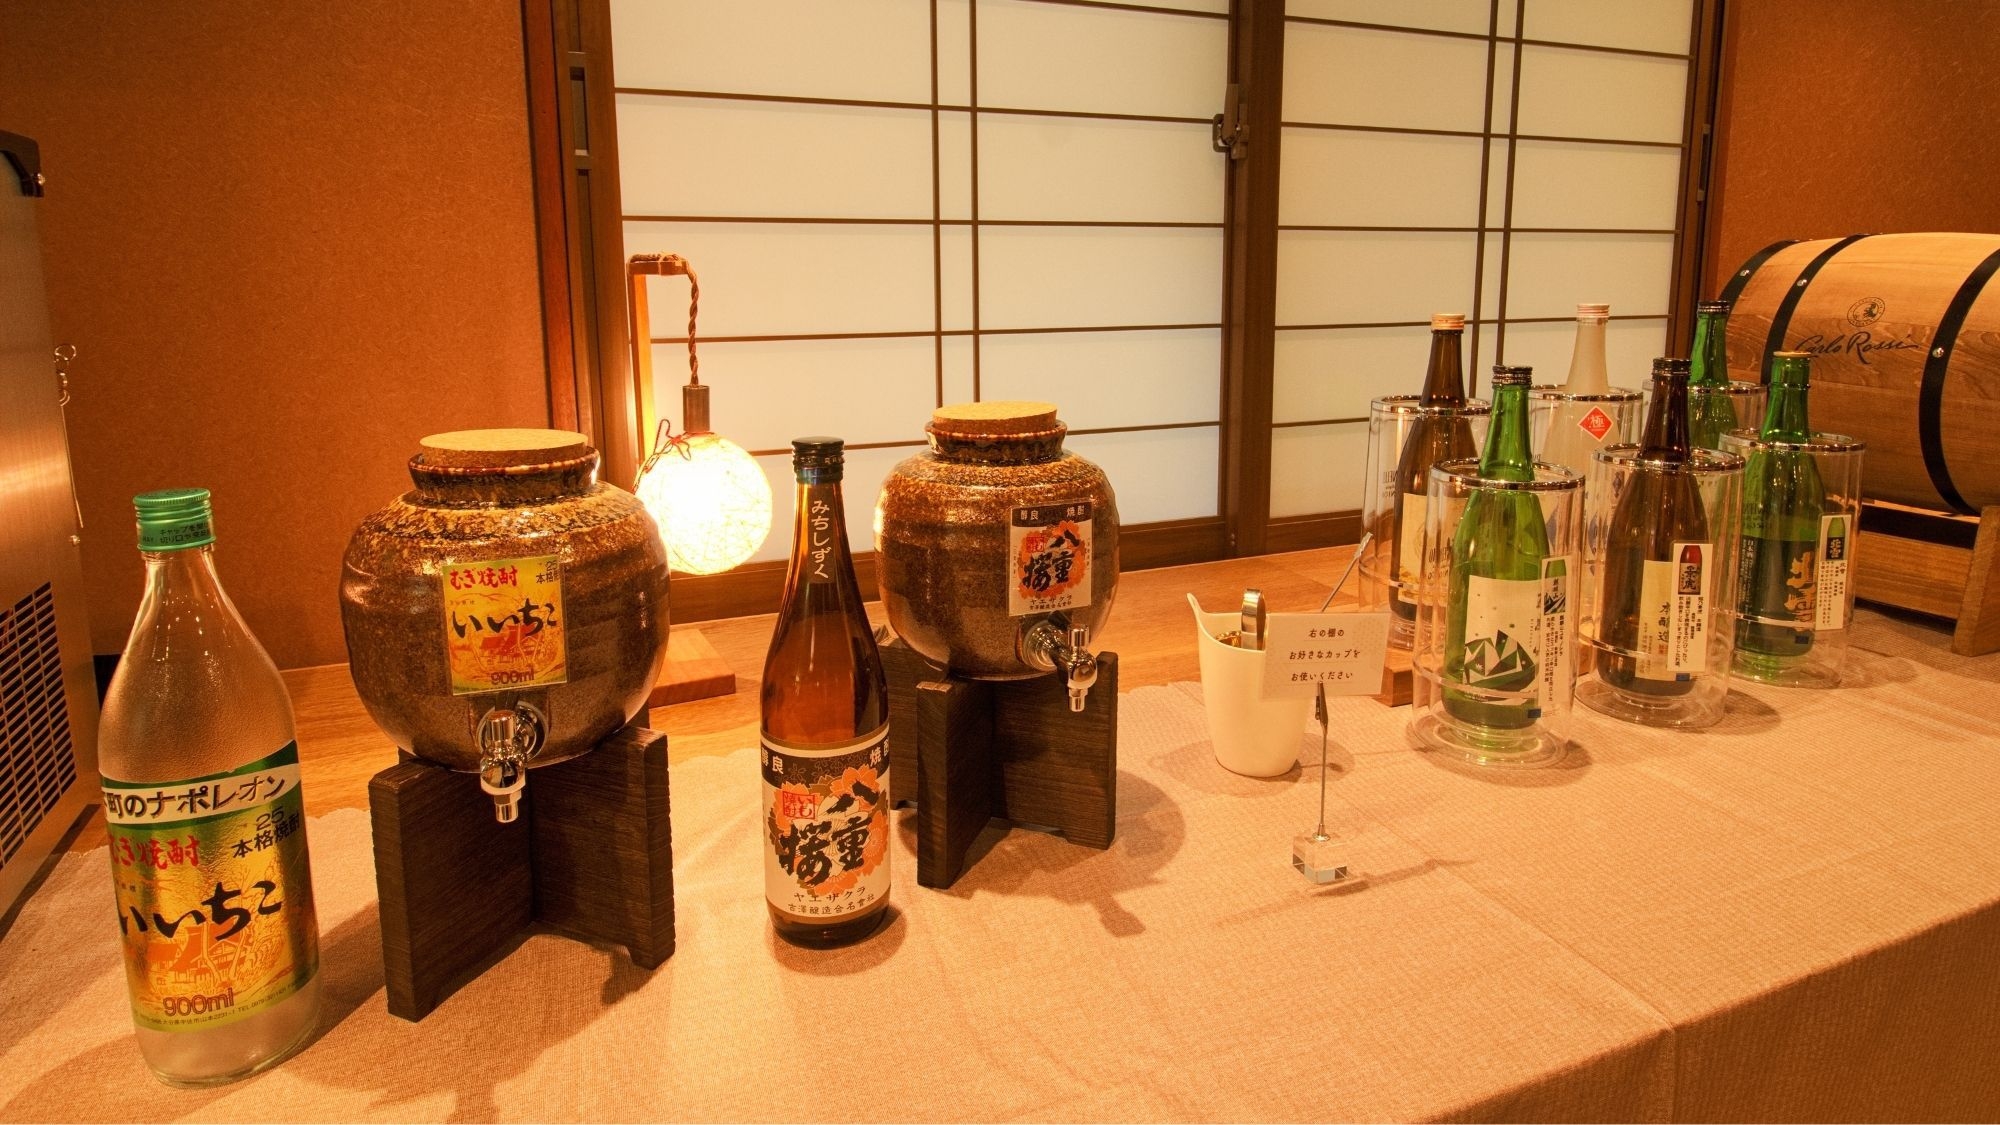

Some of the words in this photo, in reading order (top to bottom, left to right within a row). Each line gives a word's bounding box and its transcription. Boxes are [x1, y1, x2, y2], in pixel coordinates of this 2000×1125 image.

[1795, 334, 1846, 357] Carlo
[1846, 331, 1919, 365] Rossi
[811, 500, 832, 579] みちしずく
[450, 565, 518, 590] むぎ焼酎
[452, 598, 557, 638] いいちこ
[1309, 628, 1345, 638] 右の棚の
[1289, 649, 1360, 661] お好きなカップを
[491, 669, 534, 686] 900ml
[1291, 671, 1353, 682] お使いください
[104, 775, 286, 819] 町のナポレオン
[256, 805, 285, 831] 25
[794, 886, 866, 903] ヤエザクラ
[162, 987, 236, 1018] 900ml
